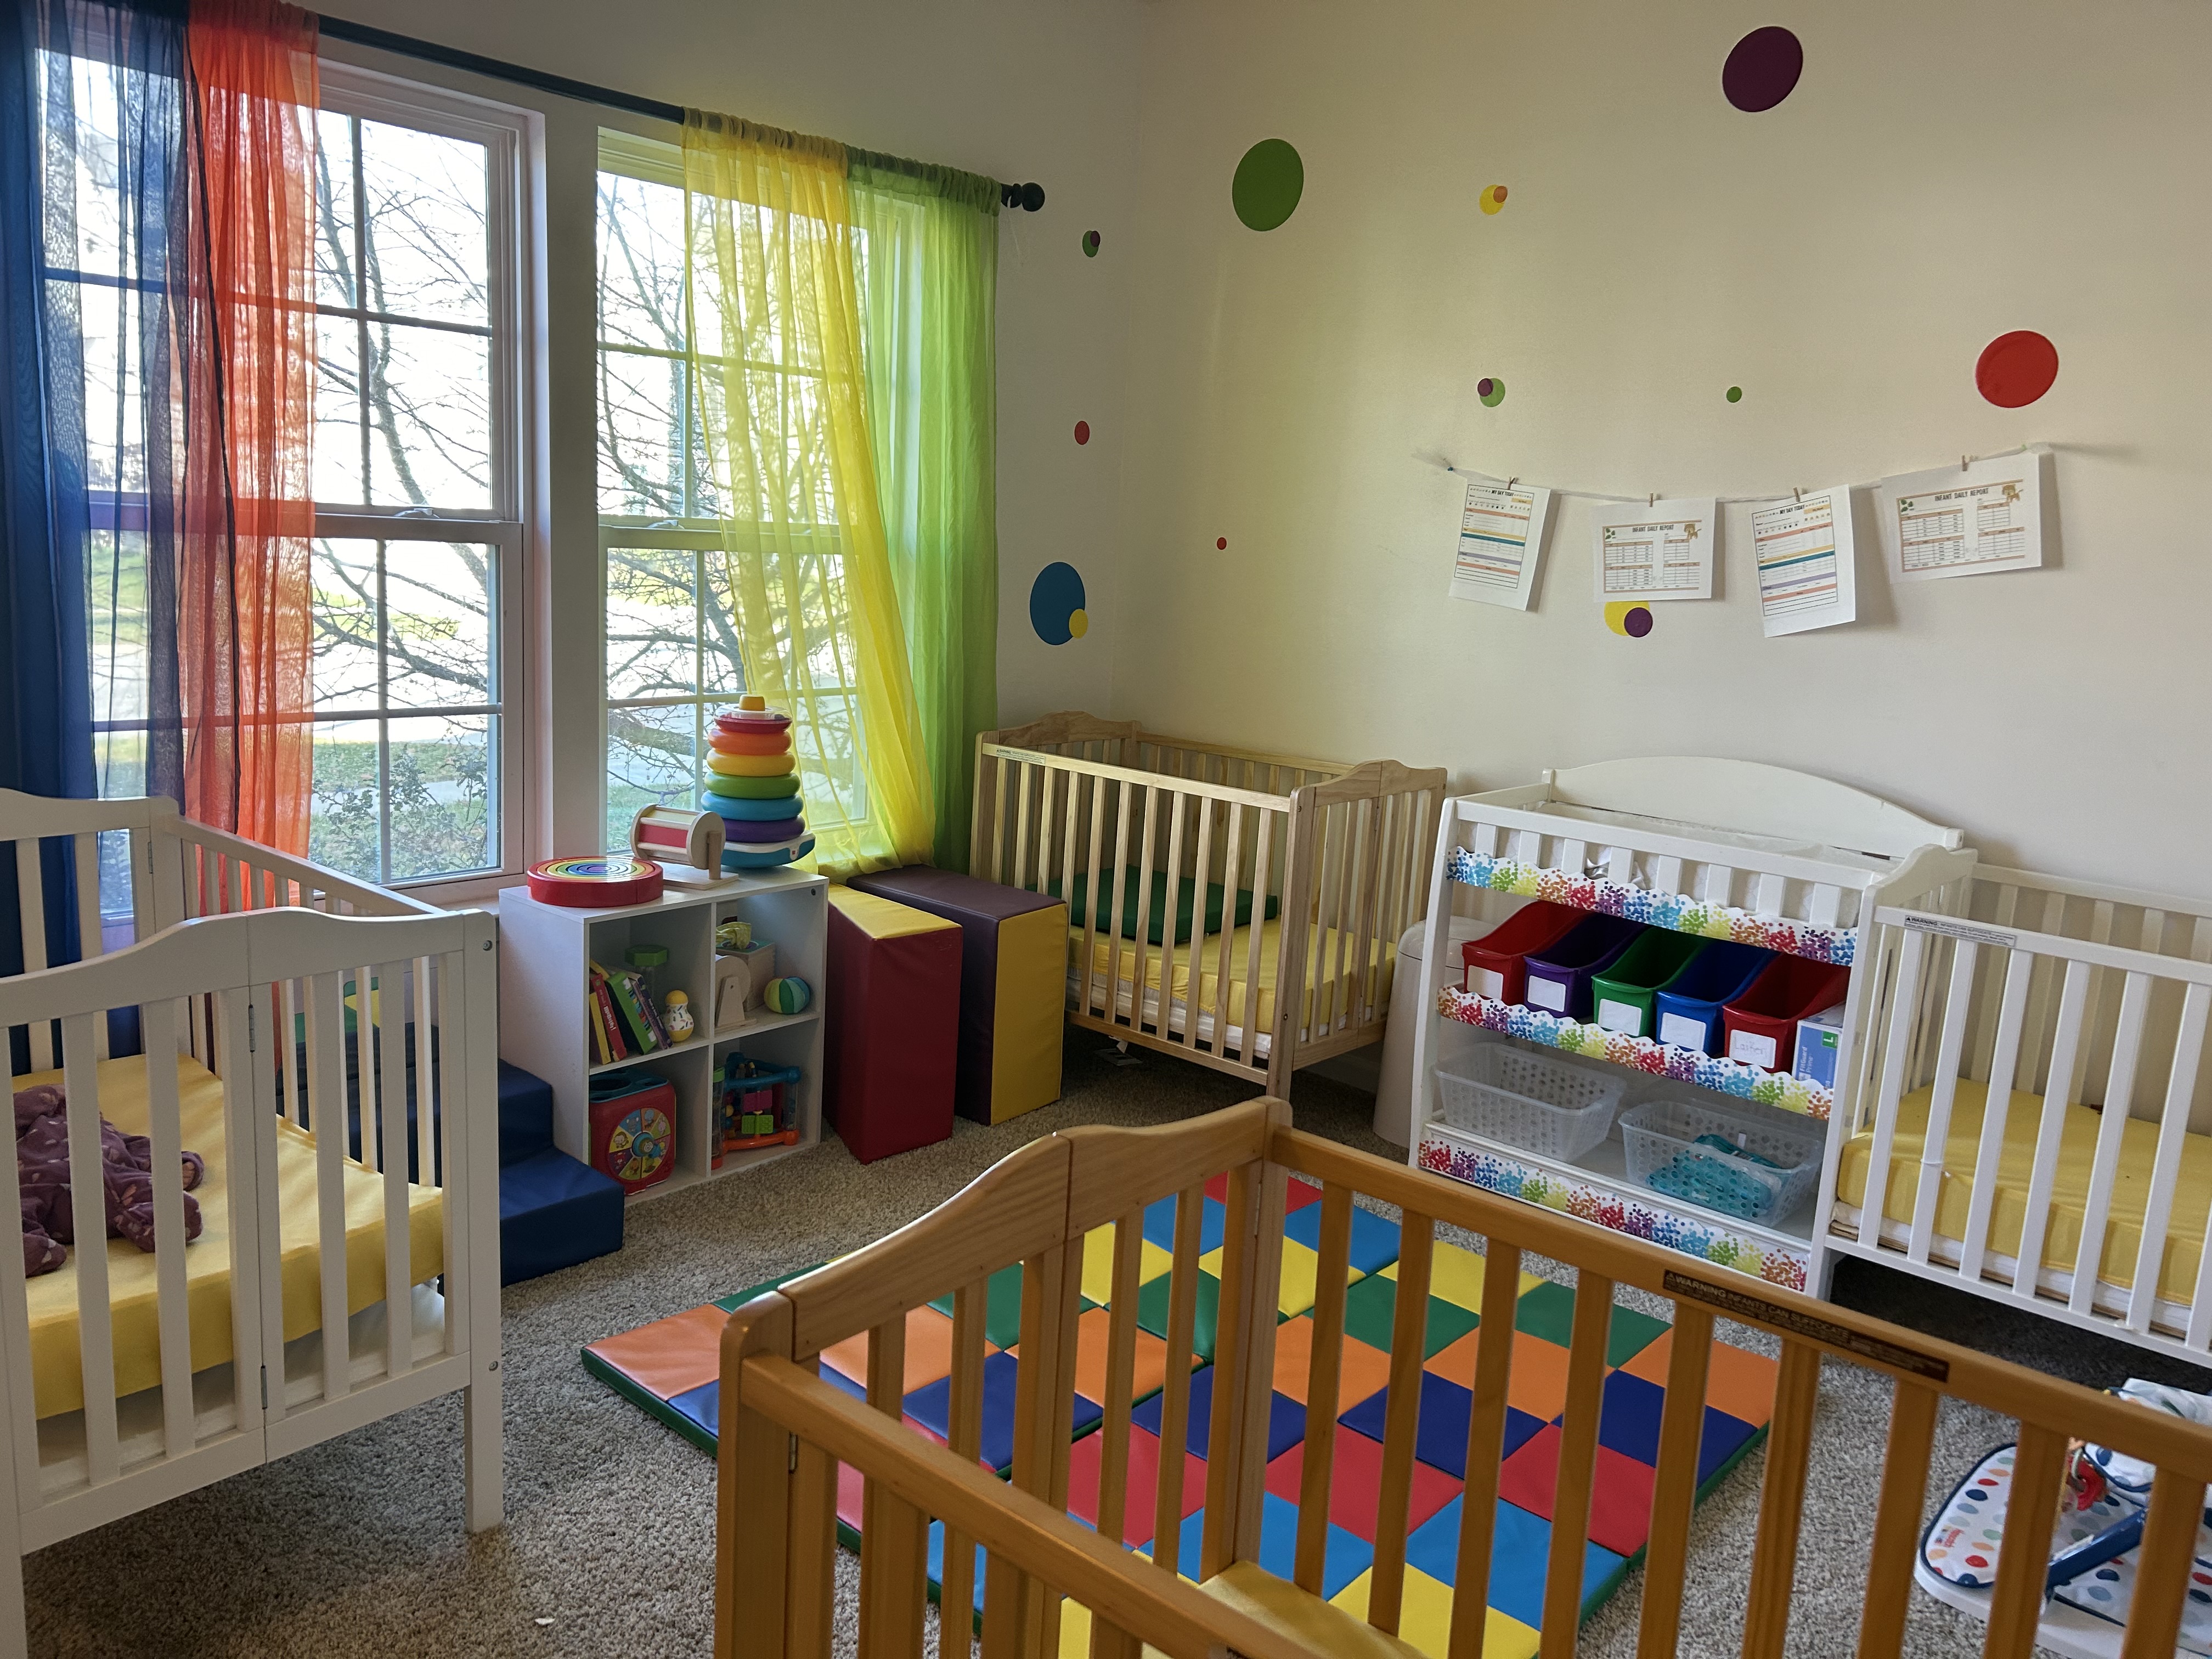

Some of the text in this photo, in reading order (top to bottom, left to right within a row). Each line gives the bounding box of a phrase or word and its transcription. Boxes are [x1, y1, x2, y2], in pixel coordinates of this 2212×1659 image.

[1970, 488, 1988, 496] REPORT
[1799, 1046, 1808, 1071] FitGuard
[1675, 1275, 1726, 1297] WARNING
[1768, 1305, 1790, 1317] CAN
